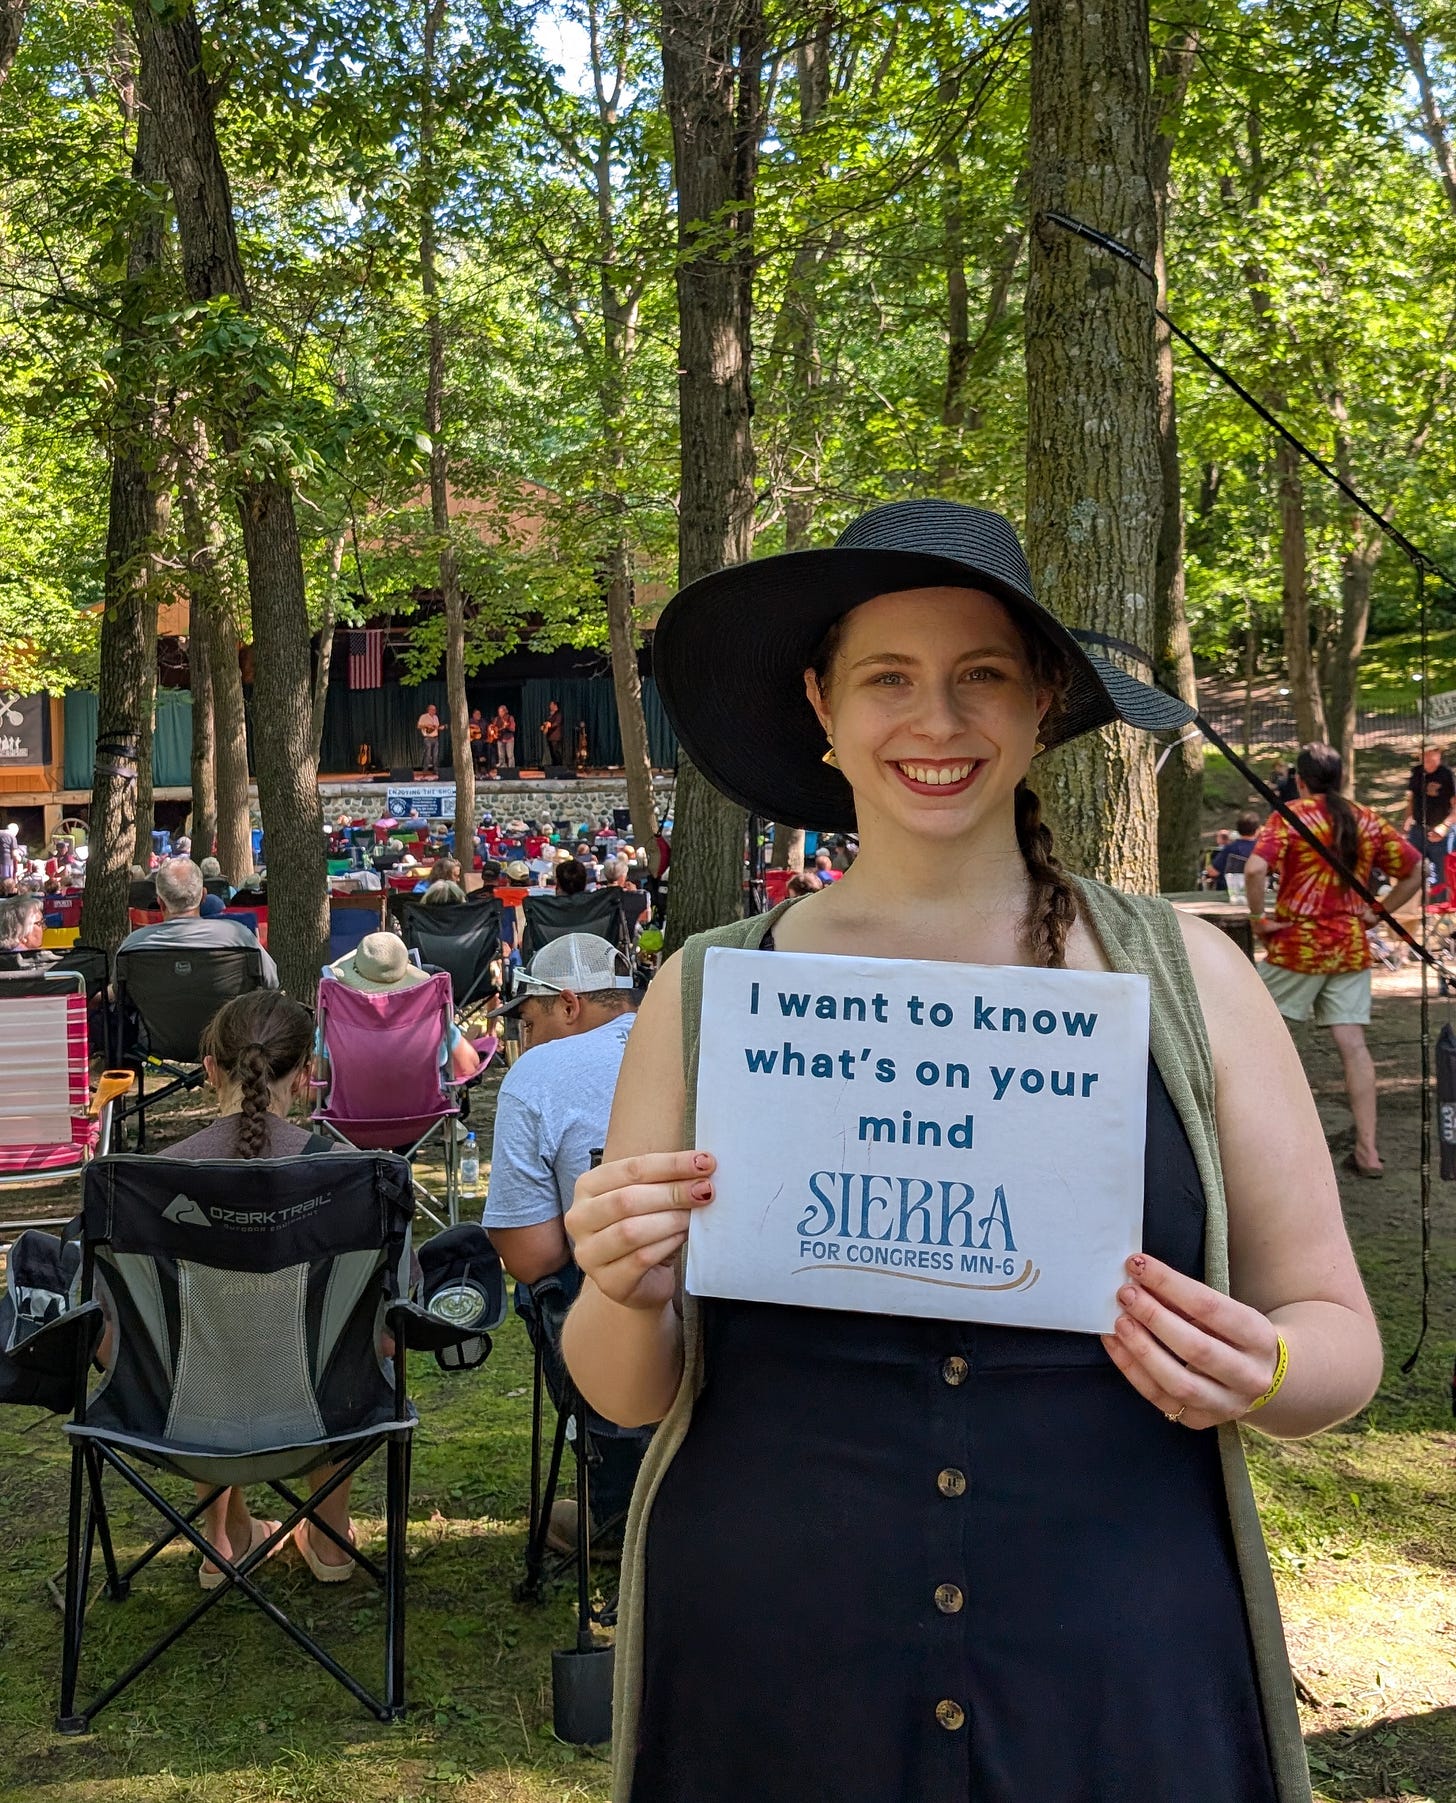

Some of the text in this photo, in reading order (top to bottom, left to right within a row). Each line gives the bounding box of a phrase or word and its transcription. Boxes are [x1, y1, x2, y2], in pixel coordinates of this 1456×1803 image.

[750, 982, 1099, 1038] I want to know
[744, 1042, 1099, 1100] what's on your
[858, 1111, 974, 1150] mind
[223, 1223, 266, 1233] OUTDOOR
[796, 1170, 1018, 1253] SIERRA
[799, 1240, 1016, 1277] FOR CONGRESS MN-6
